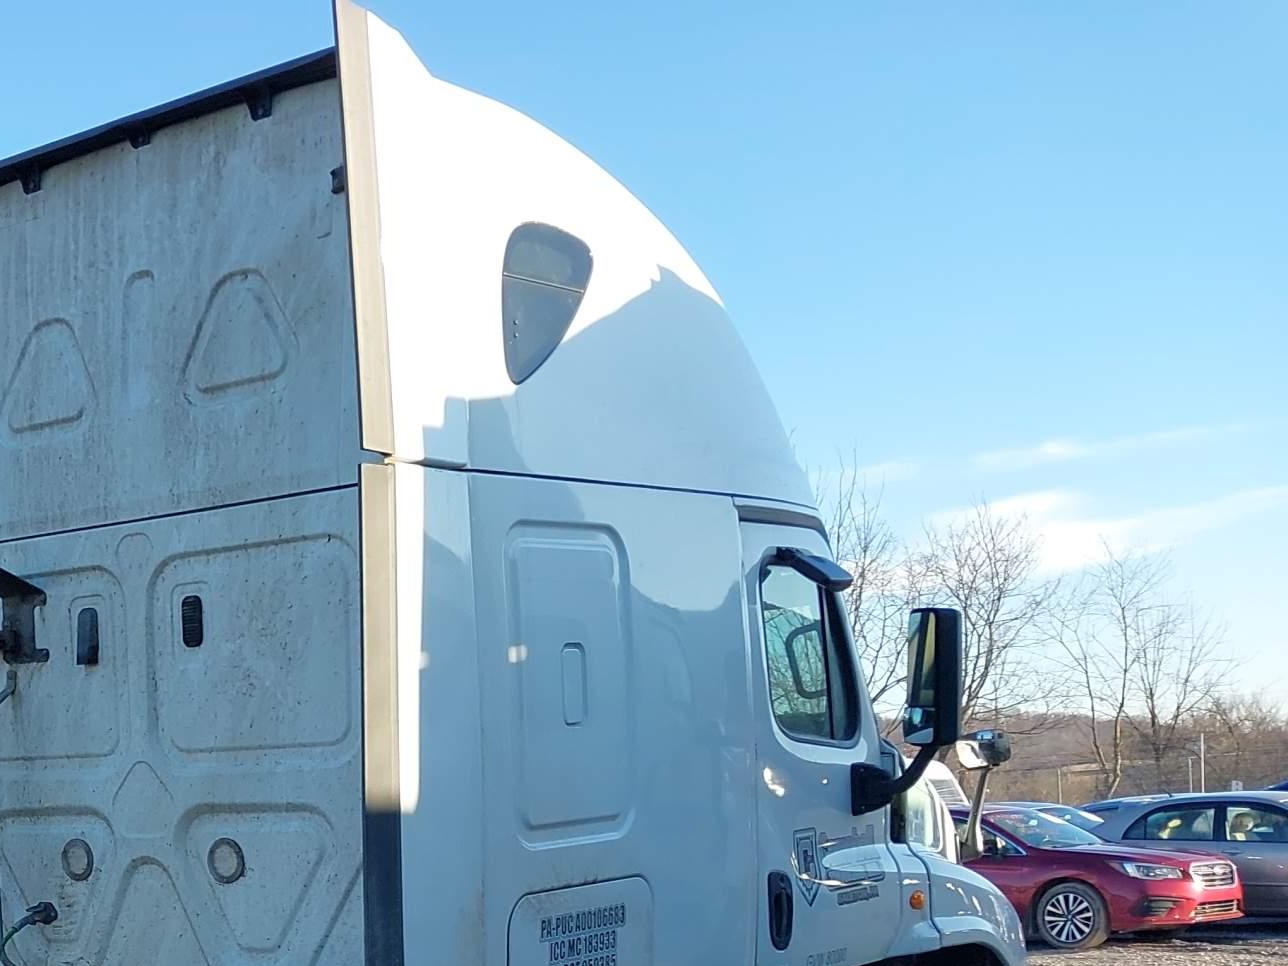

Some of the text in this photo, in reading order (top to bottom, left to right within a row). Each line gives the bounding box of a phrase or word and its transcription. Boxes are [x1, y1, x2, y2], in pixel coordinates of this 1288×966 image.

[540, 904, 626, 939] PA-PUC A00106683
[550, 930, 617, 961] ICC MC 183933
